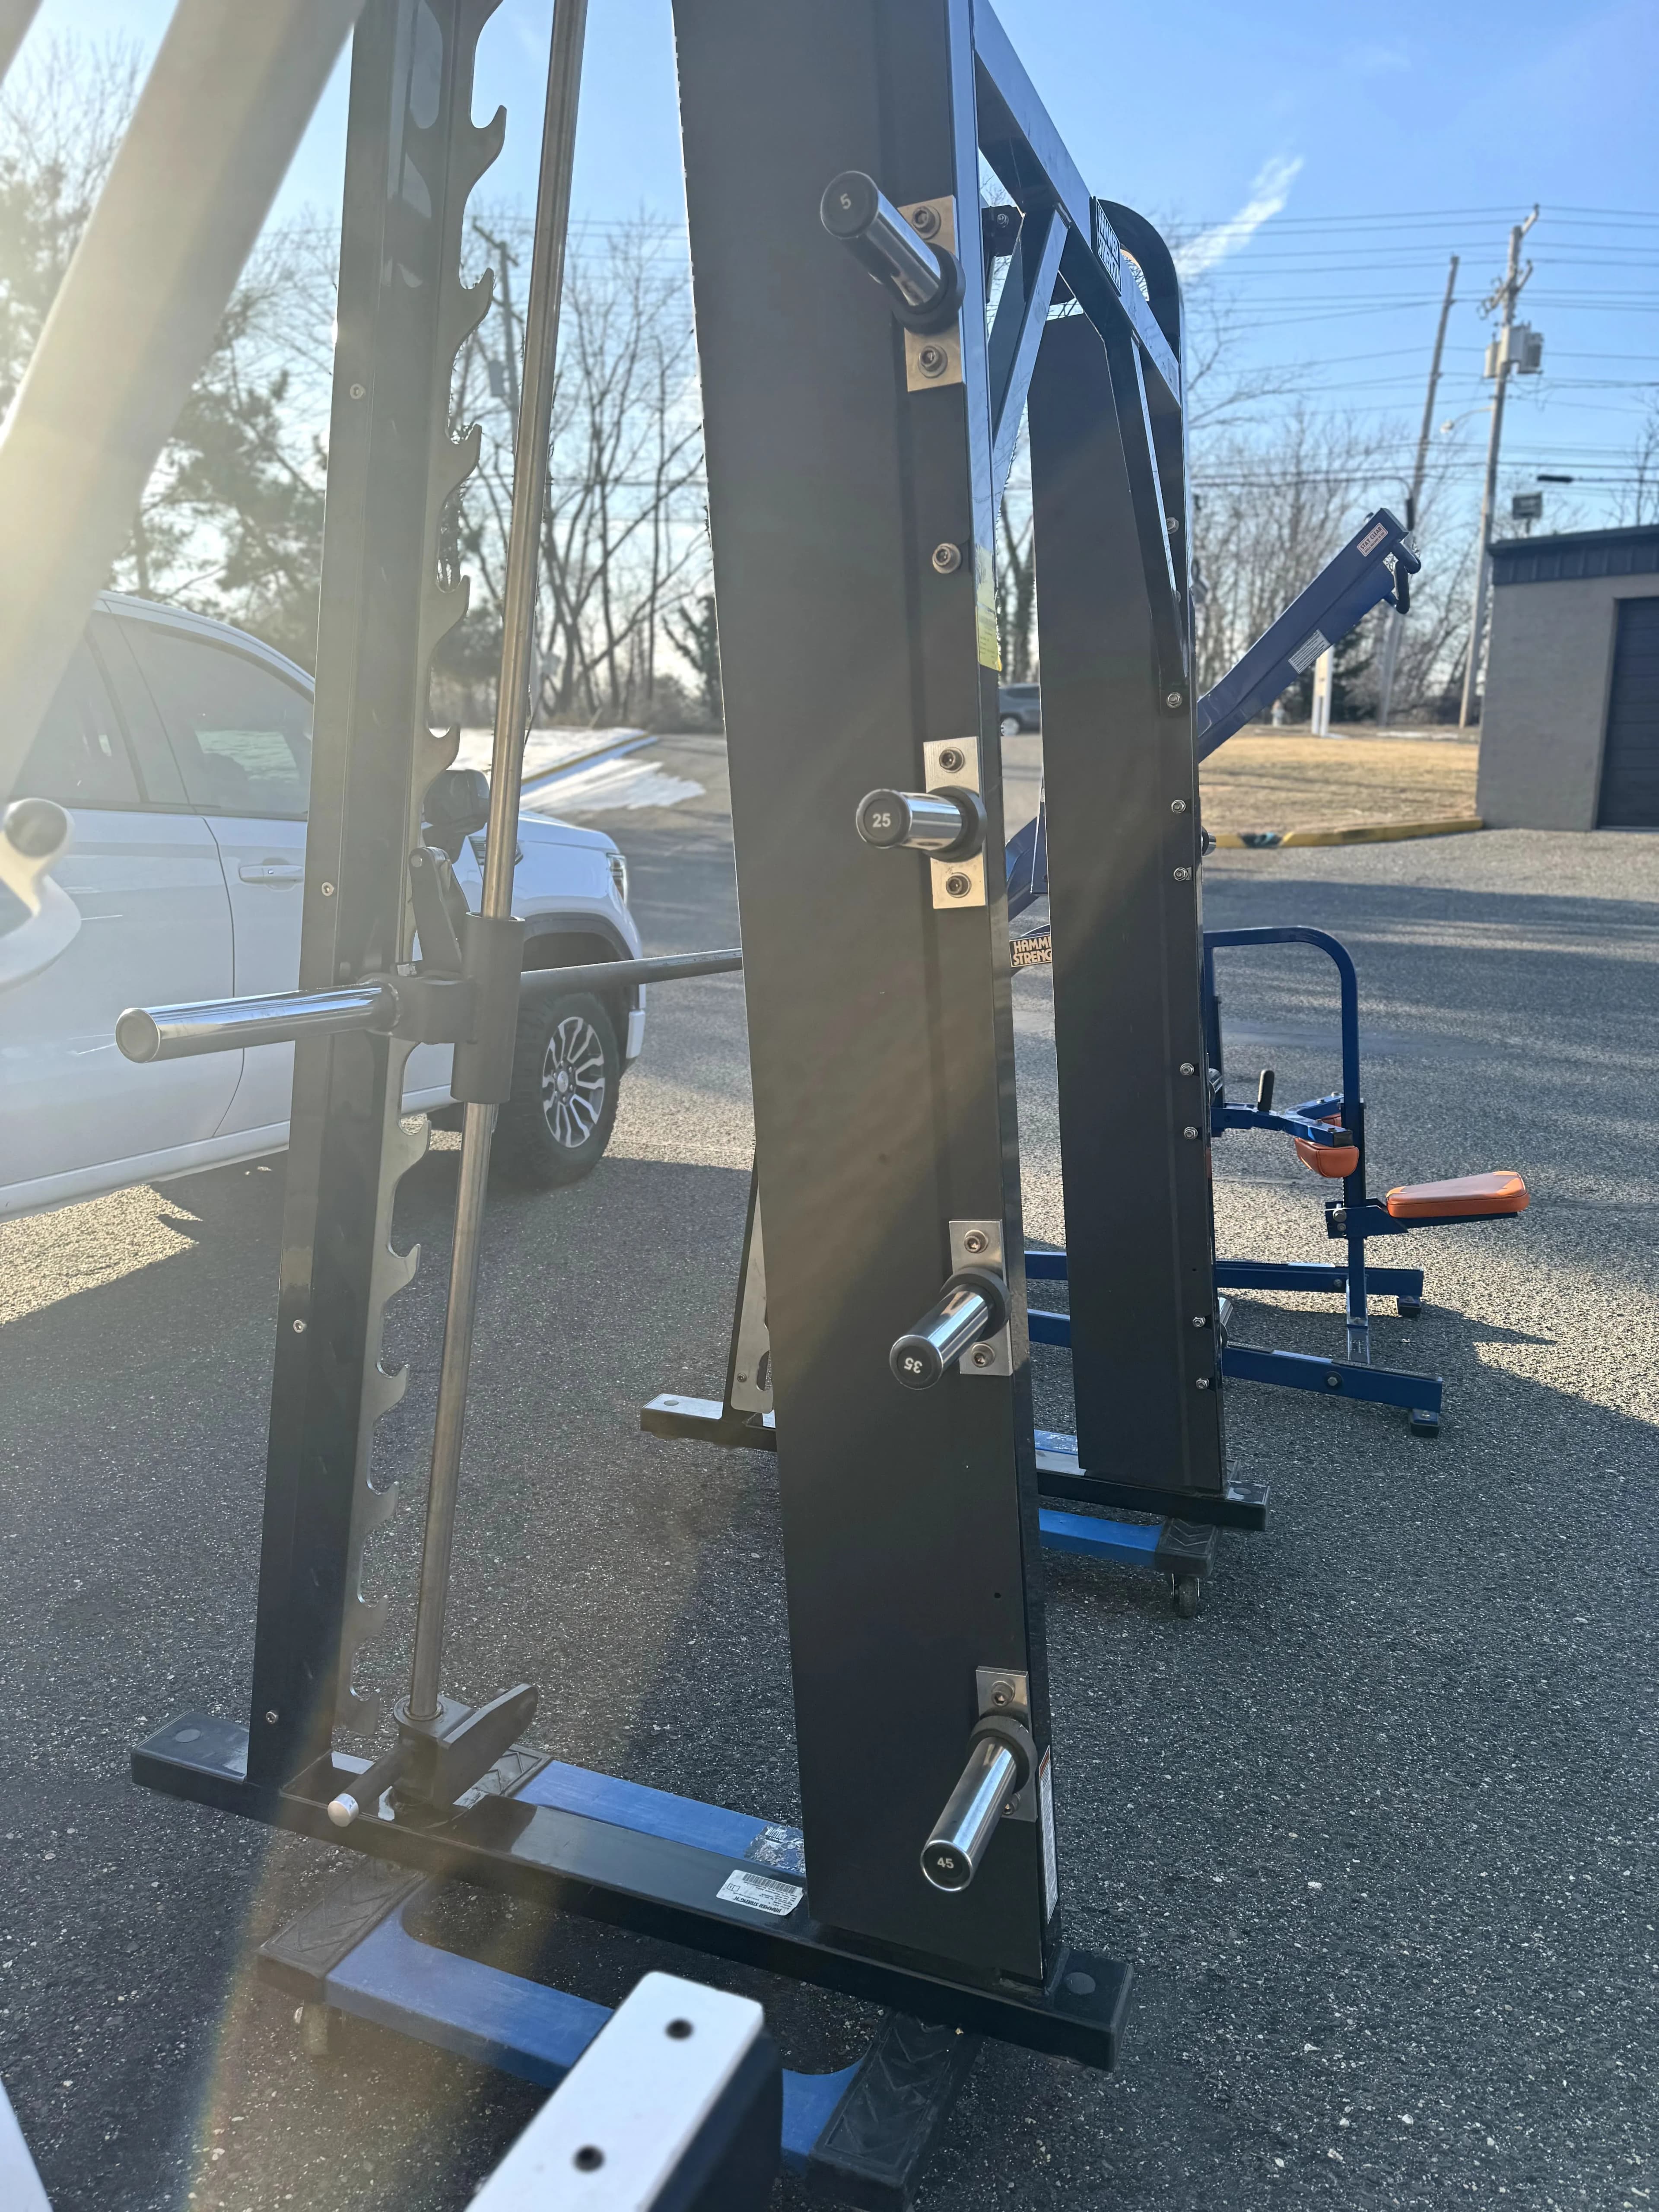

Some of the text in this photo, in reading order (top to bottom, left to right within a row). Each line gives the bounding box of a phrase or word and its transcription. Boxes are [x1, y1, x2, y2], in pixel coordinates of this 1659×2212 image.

[840, 193, 852, 210] 5
[1360, 538, 1370, 550] STAY
[1370, 526, 1382, 539] CLEAR
[872, 813, 891, 828] 25
[904, 1357, 922, 1373] 35
[937, 1857, 954, 1869] 45
